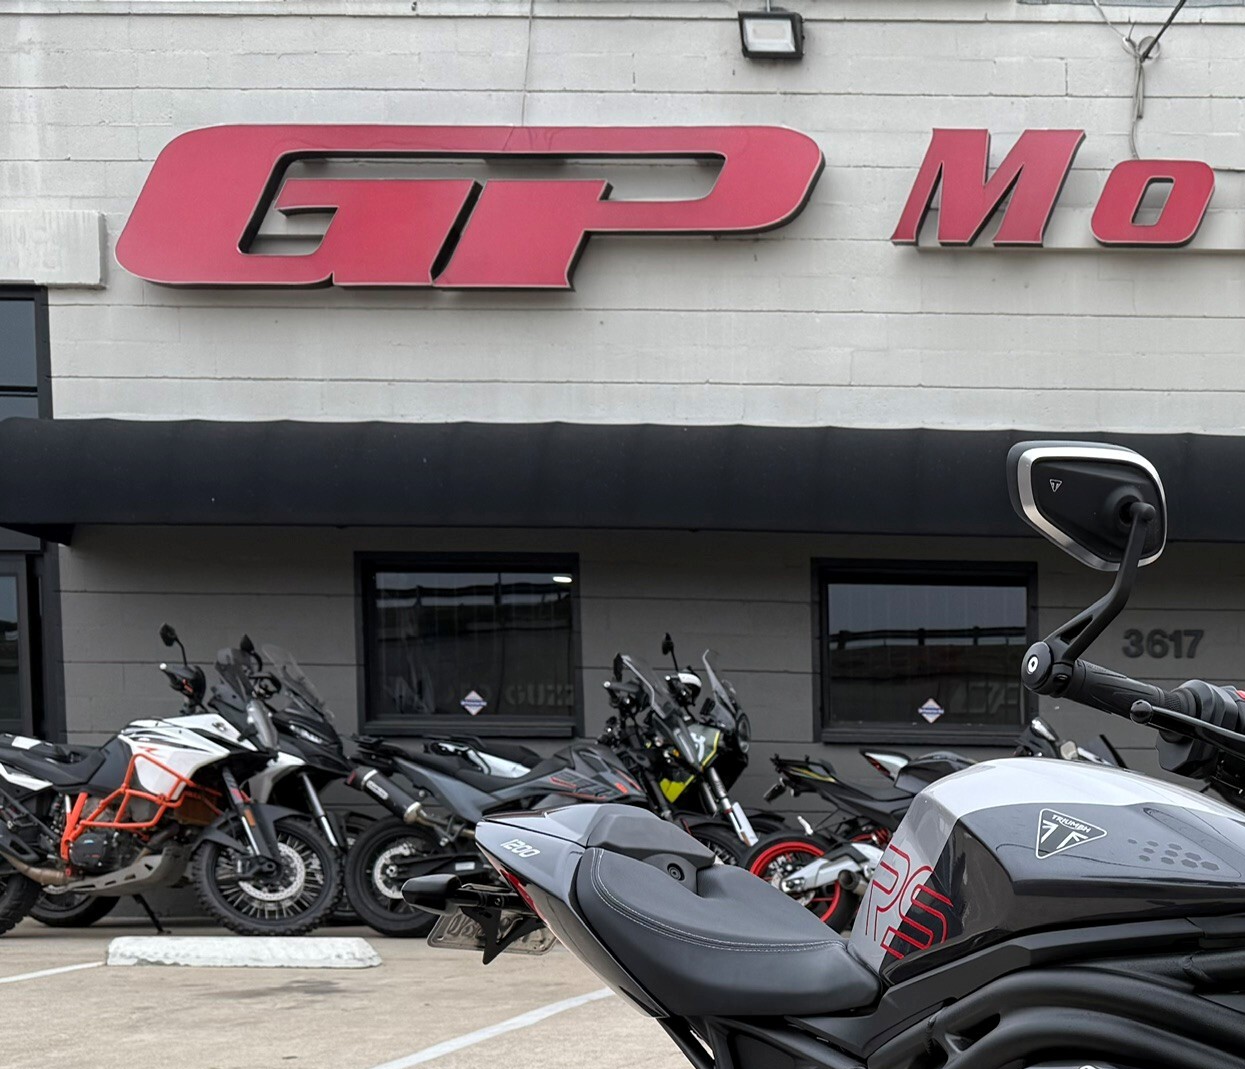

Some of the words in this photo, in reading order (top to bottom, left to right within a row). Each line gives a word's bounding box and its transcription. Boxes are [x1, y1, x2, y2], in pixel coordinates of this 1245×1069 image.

[115, 122, 826, 291] GP
[1122, 628, 1205, 658] 3617
[1052, 814, 1092, 833] TRIUMPH
[500, 838, 541, 858] 1200
